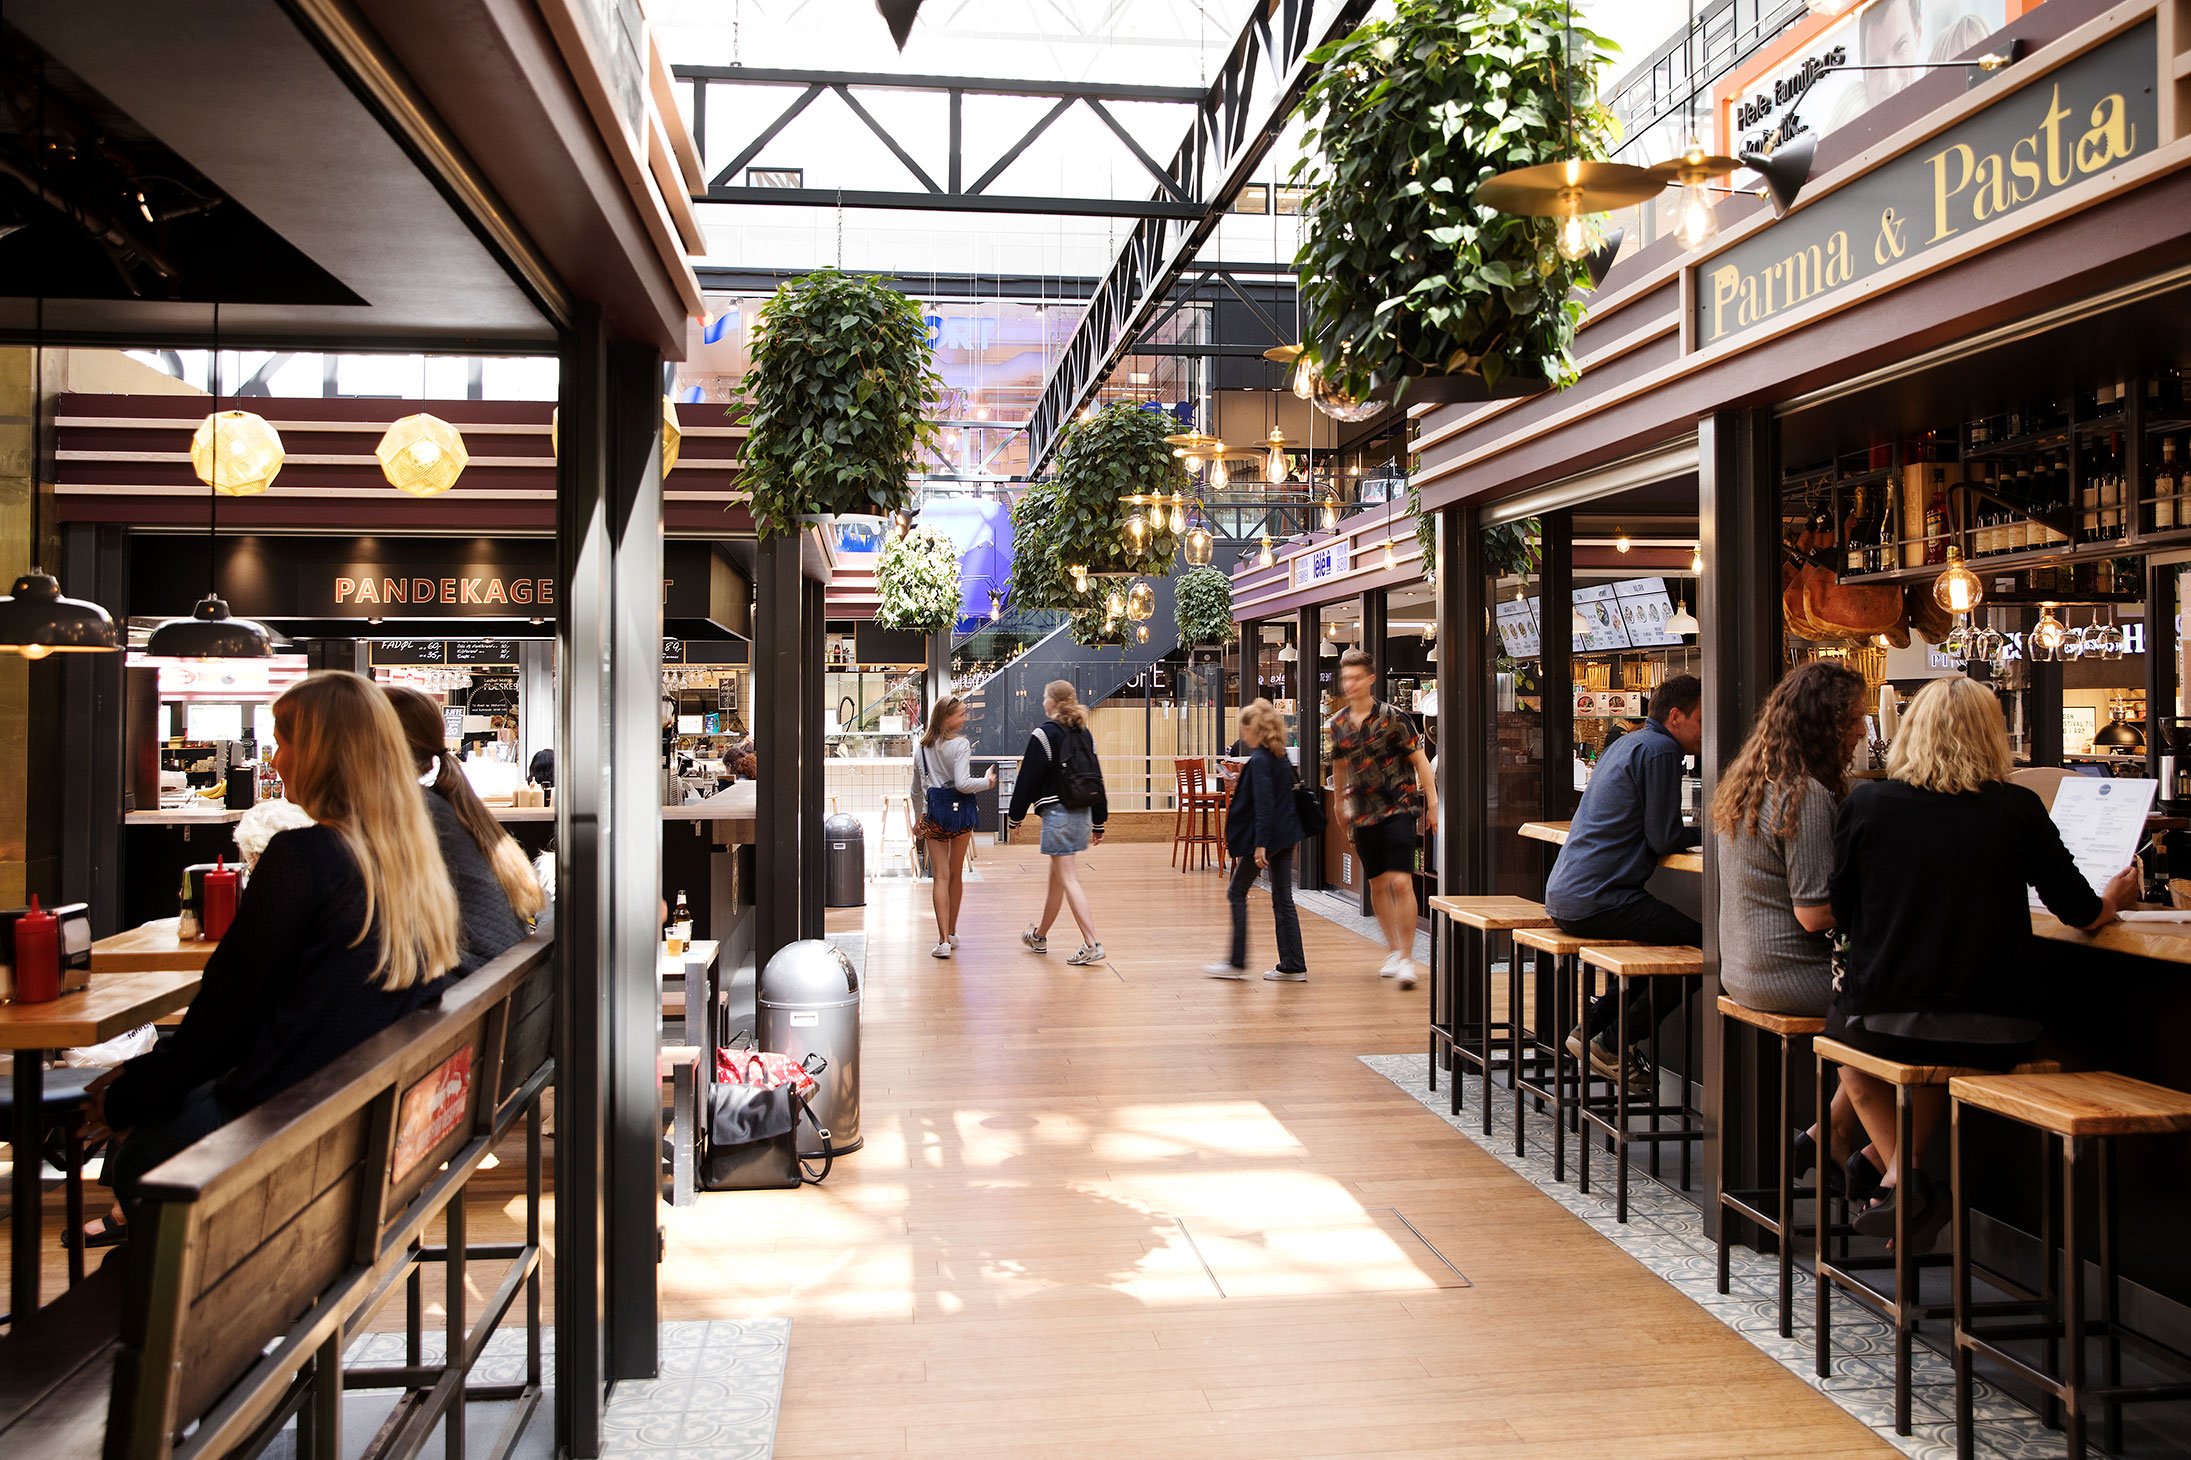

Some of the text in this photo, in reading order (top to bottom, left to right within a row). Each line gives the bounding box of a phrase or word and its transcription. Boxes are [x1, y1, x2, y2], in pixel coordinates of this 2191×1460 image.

[1737, 45, 1846, 132] Hele familiens
[1707, 82, 2137, 342] Parma & Pasta
[908, 314, 996, 351] ORT
